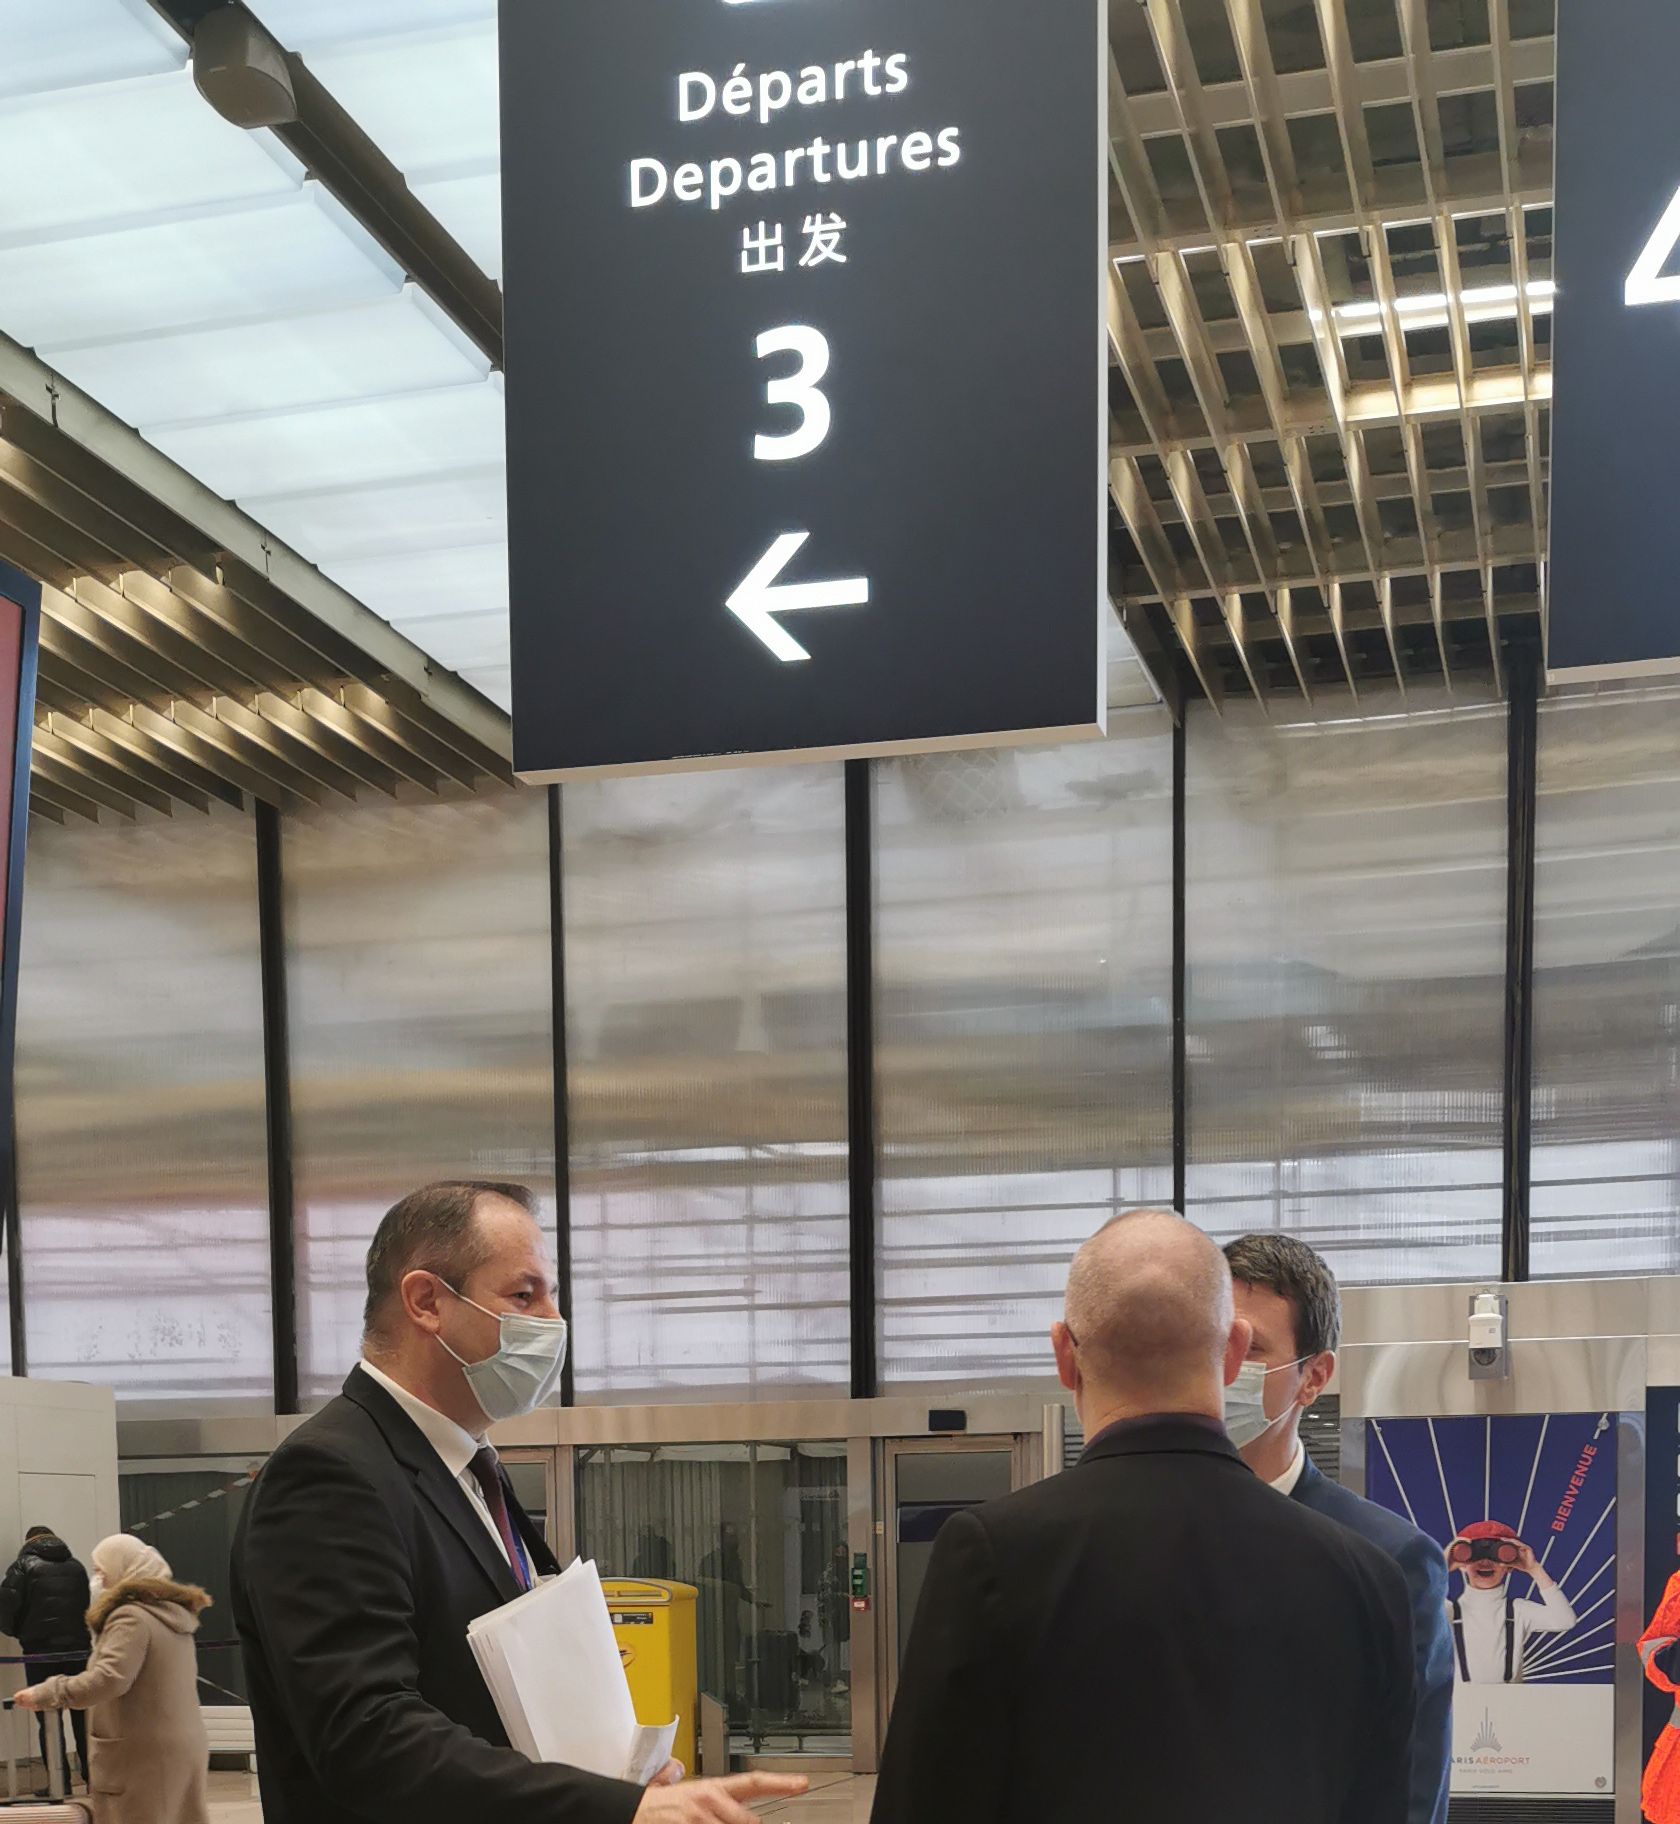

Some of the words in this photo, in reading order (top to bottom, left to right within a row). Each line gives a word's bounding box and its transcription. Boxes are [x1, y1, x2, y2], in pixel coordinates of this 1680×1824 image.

[677, 48, 909, 125] Départs
[629, 126, 962, 211] Departures
[740, 212, 848, 274] 出发
[753, 323, 832, 461] 3
[1551, 1444, 1597, 1532] BIENVENUE
